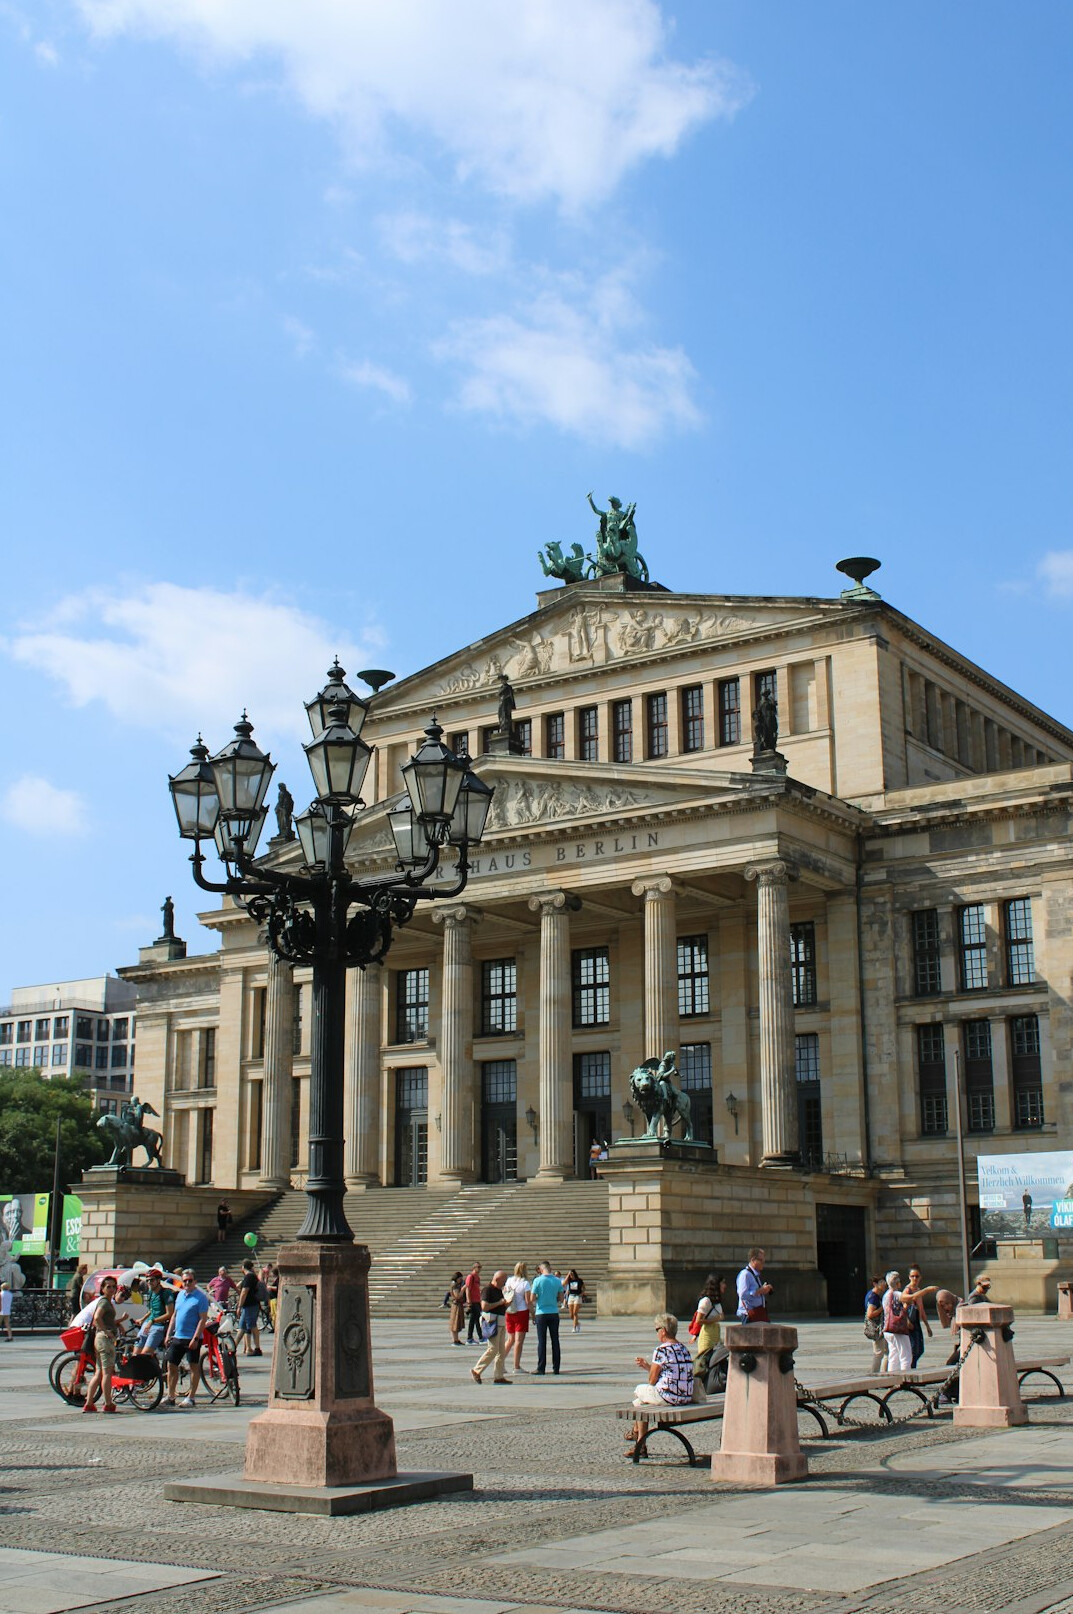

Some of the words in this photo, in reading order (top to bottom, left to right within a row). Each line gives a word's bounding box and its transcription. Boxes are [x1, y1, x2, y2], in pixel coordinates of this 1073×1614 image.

[555, 832, 659, 862] BERLIN
[1011, 1166, 1017, 1175] &
[982, 1176, 1014, 1188] Herzlich
[1015, 1175, 1065, 1186] Willkommen
